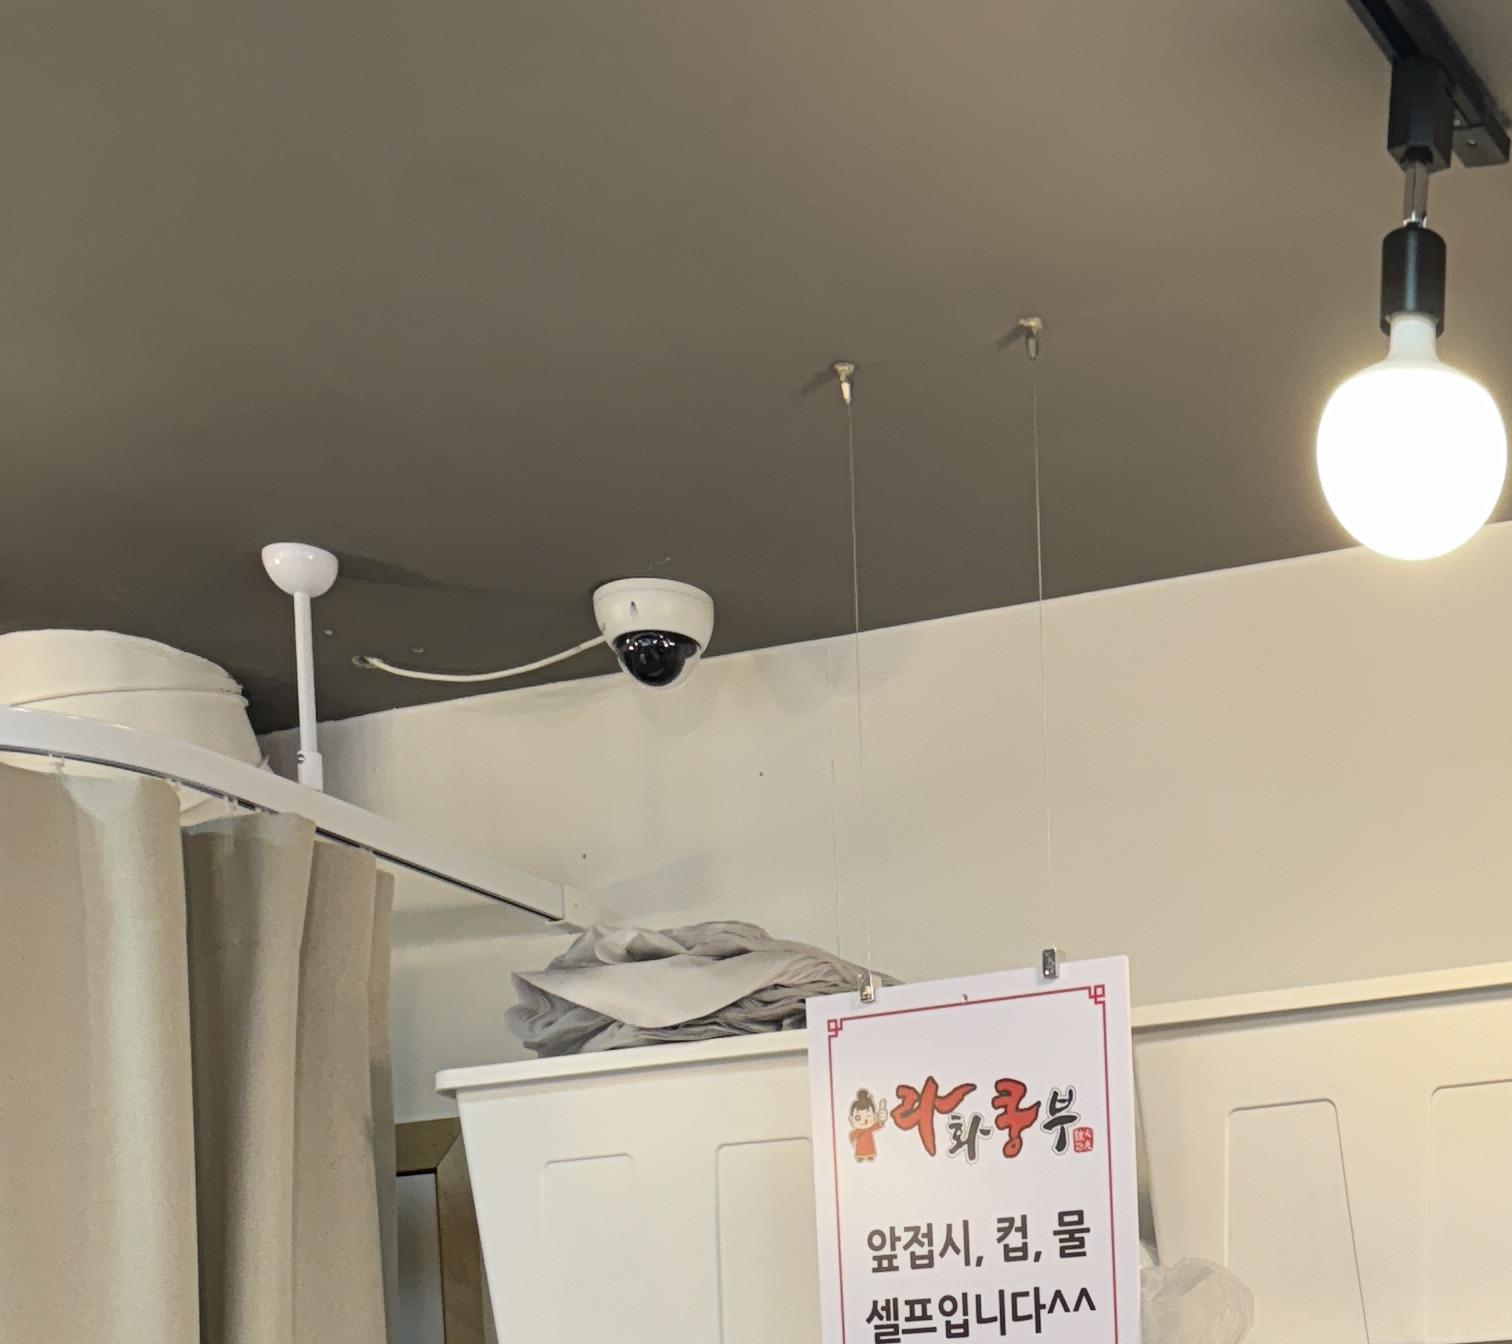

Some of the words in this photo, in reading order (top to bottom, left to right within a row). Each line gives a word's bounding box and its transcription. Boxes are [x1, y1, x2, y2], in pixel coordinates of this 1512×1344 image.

[866, 1217, 985, 1274] 앞접시,
[995, 1214, 1044, 1264] 컵,
[1052, 1208, 1091, 1260] 물
[865, 1285, 1097, 1344] 셀프입니다^^
